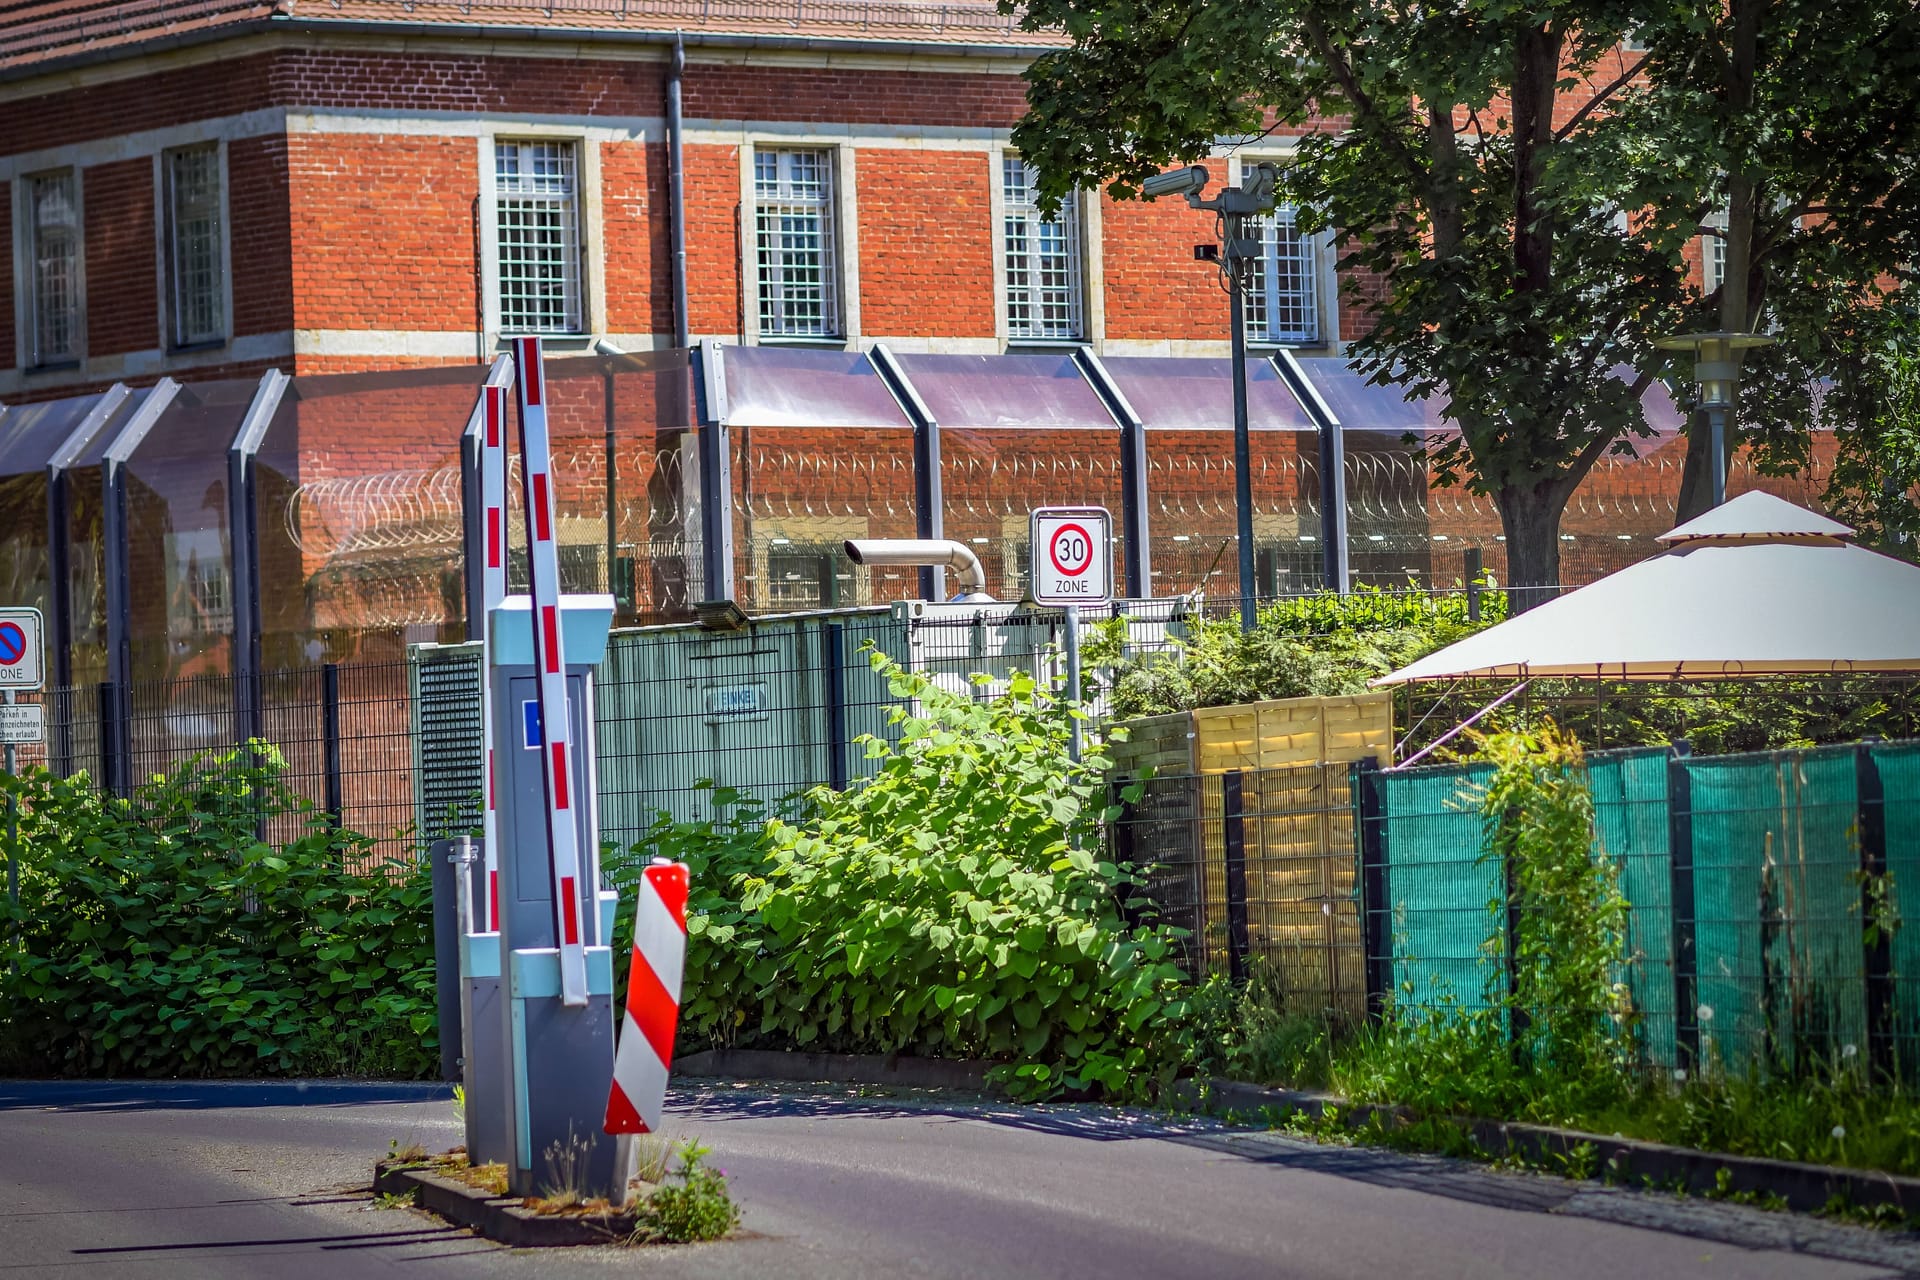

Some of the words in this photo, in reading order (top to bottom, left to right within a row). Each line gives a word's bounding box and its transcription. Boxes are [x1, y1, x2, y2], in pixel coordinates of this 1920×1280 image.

[1059, 538, 1085, 562] 30
[1056, 580, 1088, 593] ZONE
[0, 668, 23, 679] ONE
[22, 710, 28, 718] in
[0, 720, 40, 728] nnzeichneten
[16, 729, 37, 738] erlaubt
